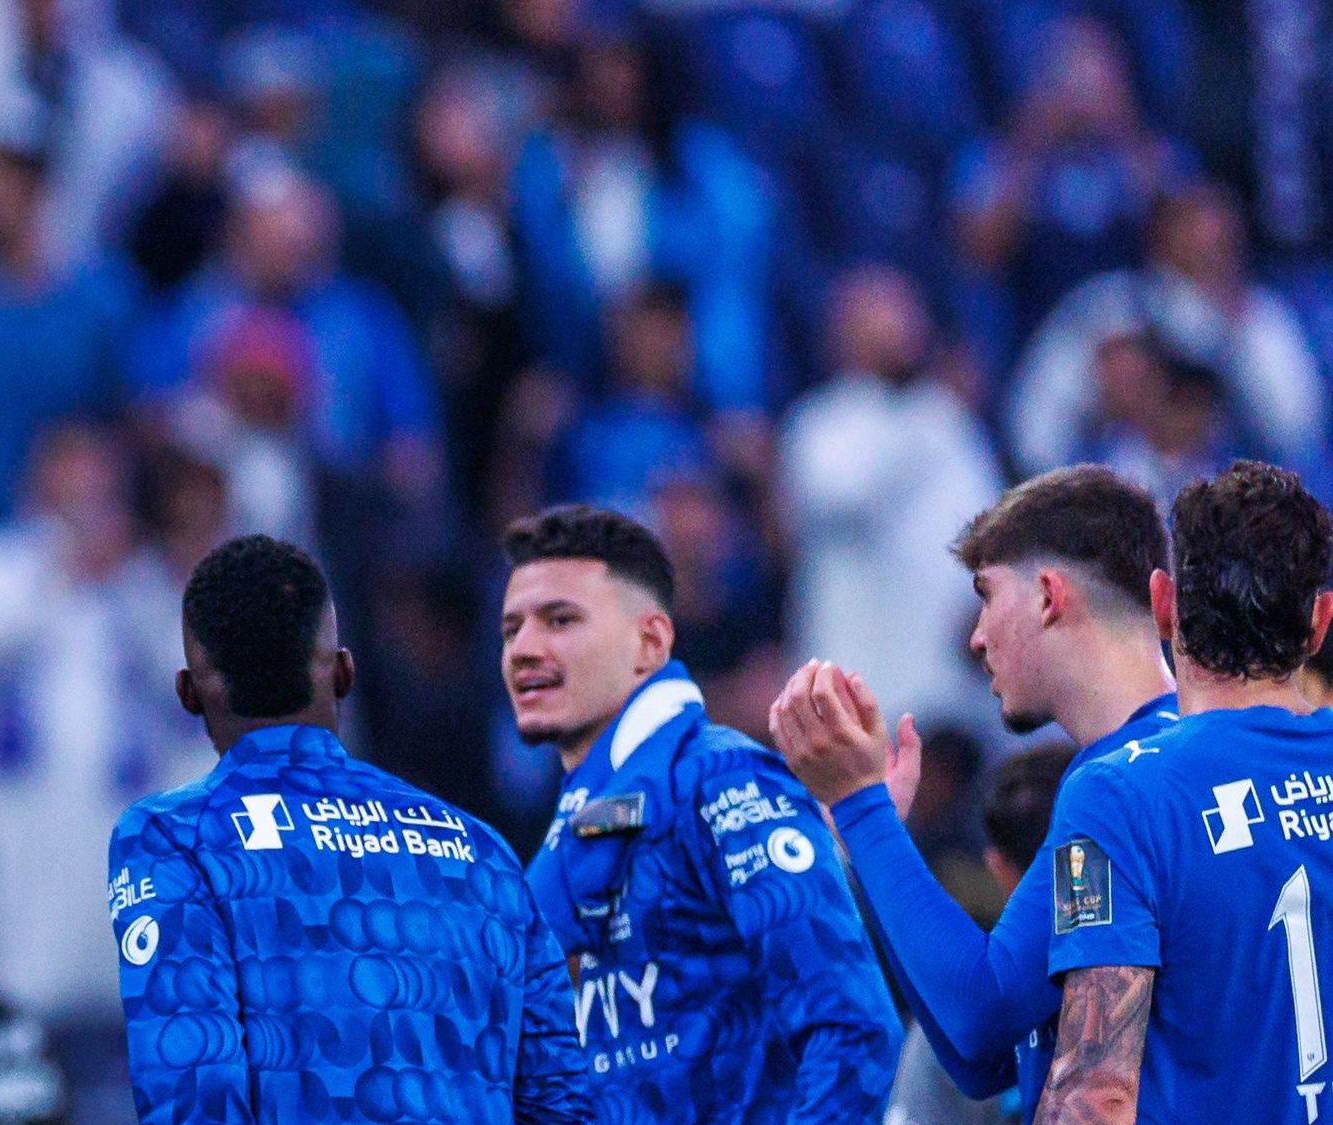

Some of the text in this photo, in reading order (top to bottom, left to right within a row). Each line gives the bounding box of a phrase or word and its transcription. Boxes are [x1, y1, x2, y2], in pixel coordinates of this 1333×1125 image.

[302, 797, 389, 827] الرياض
[310, 824, 475, 863] Riyad Bank
